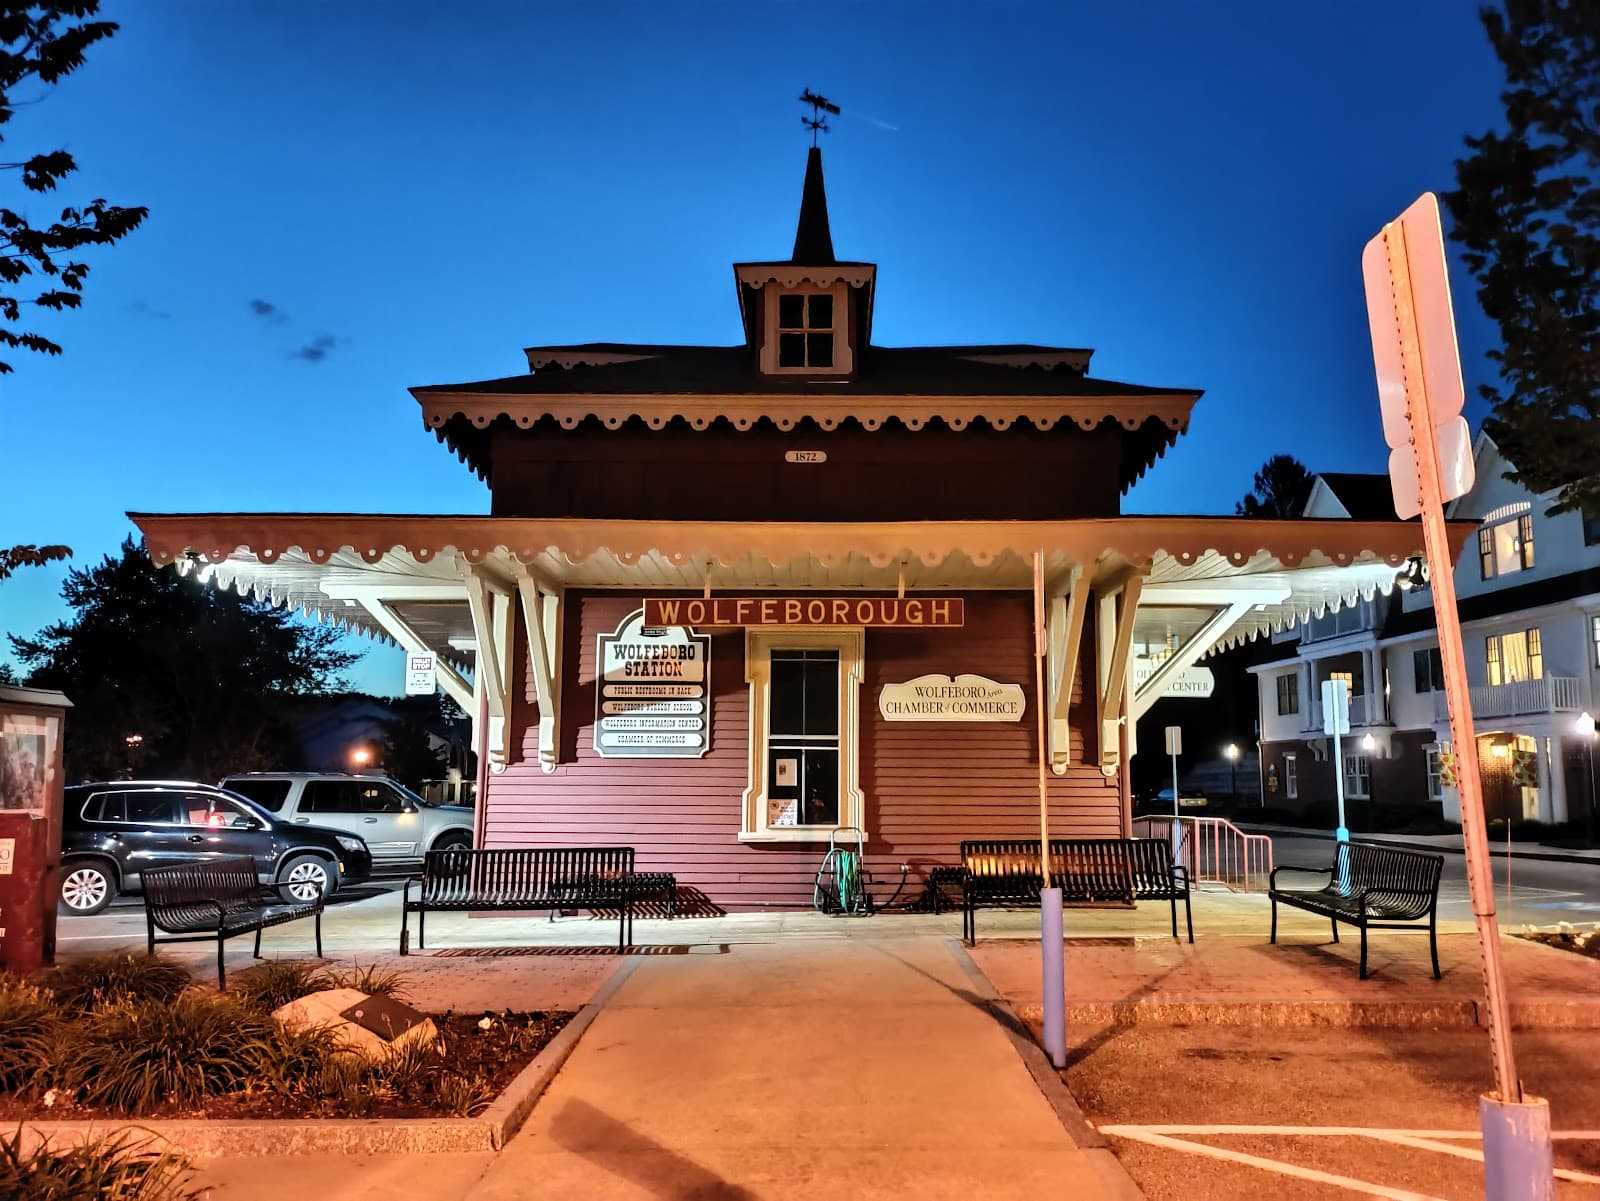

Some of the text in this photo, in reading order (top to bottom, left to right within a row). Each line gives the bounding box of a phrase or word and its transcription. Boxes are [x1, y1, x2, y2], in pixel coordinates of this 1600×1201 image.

[795, 452, 817, 461] 1872
[658, 600, 950, 624] WOLFEBOROUGH
[613, 644, 695, 660] WOLFEBORO
[625, 661, 682, 676] STATION
[614, 686, 692, 695] PUBLIC RESTROOMS IN BACK
[1172, 682, 1209, 691] CENTER
[915, 686, 986, 698] WOLFEBORO
[886, 701, 943, 714] CHAMBER
[952, 701, 1018, 714] COMMERCE
[604, 719, 699, 728] WOLFEBORO INFORMATION CENTER
[618, 735, 644, 743] CHAMBER
[655, 735, 686, 743] COMMERCE
